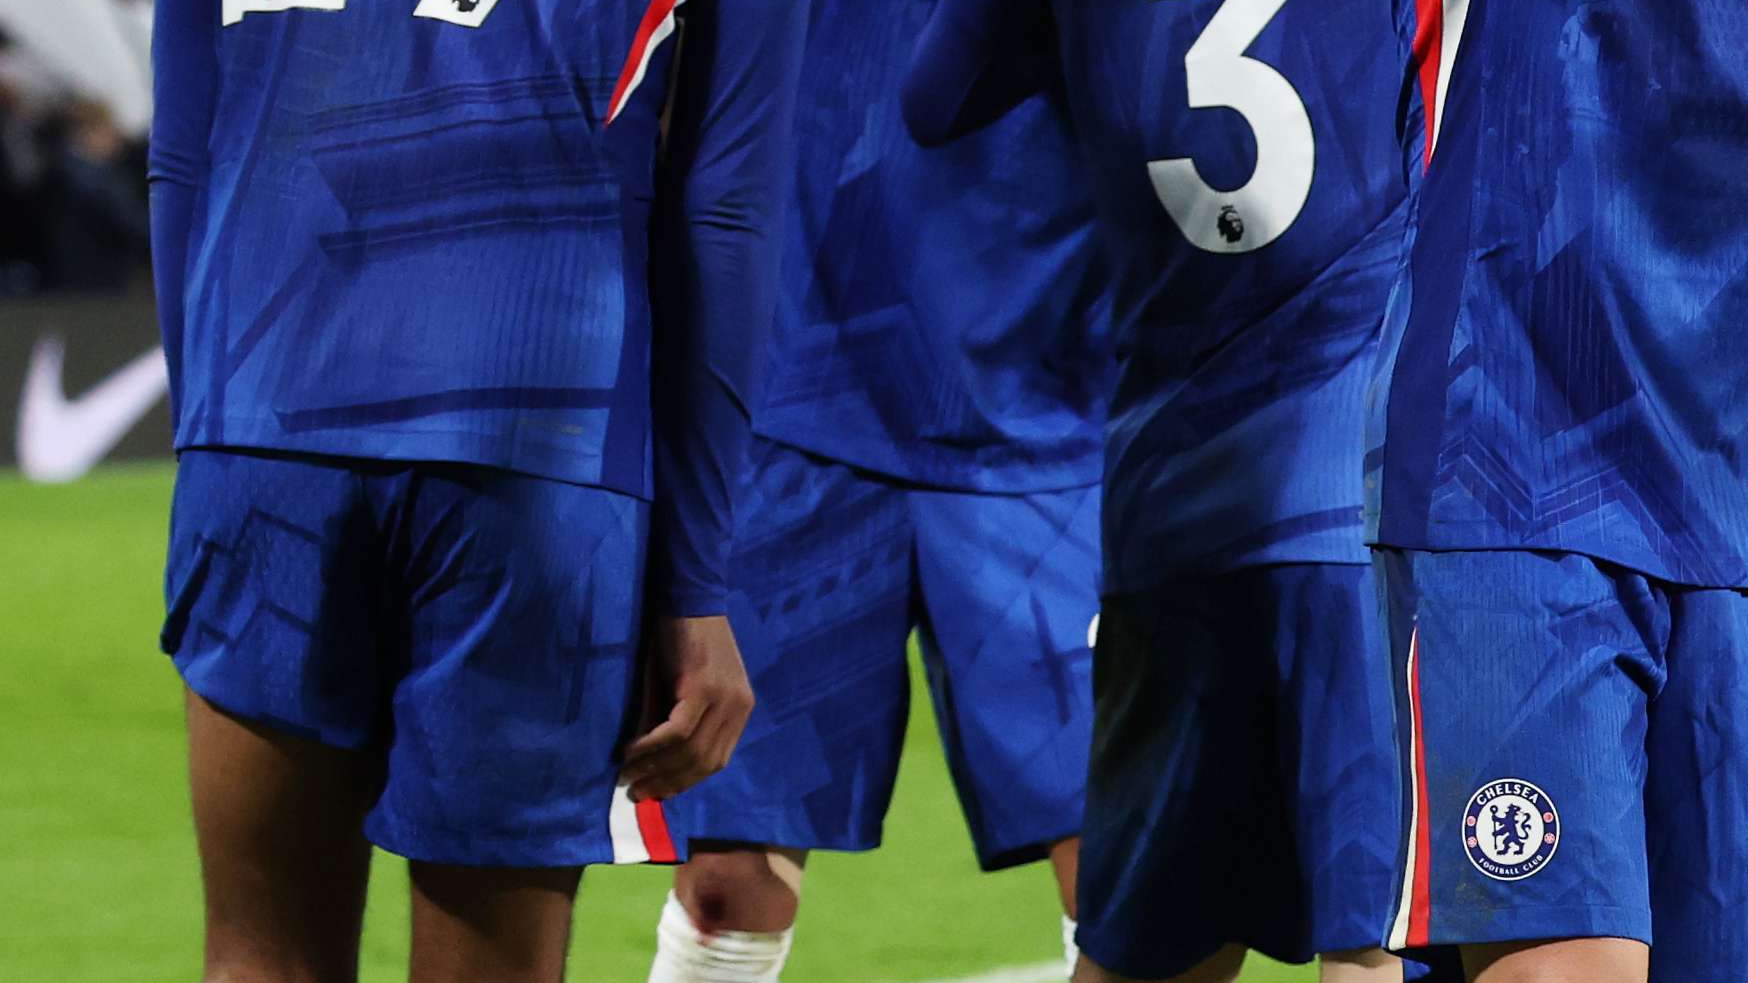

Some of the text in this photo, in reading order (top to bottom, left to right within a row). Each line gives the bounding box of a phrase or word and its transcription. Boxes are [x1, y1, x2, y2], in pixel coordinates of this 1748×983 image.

[1476, 783, 1540, 805] CHELSEA
[1478, 854, 1544, 876] FOOTBALL CLUB
